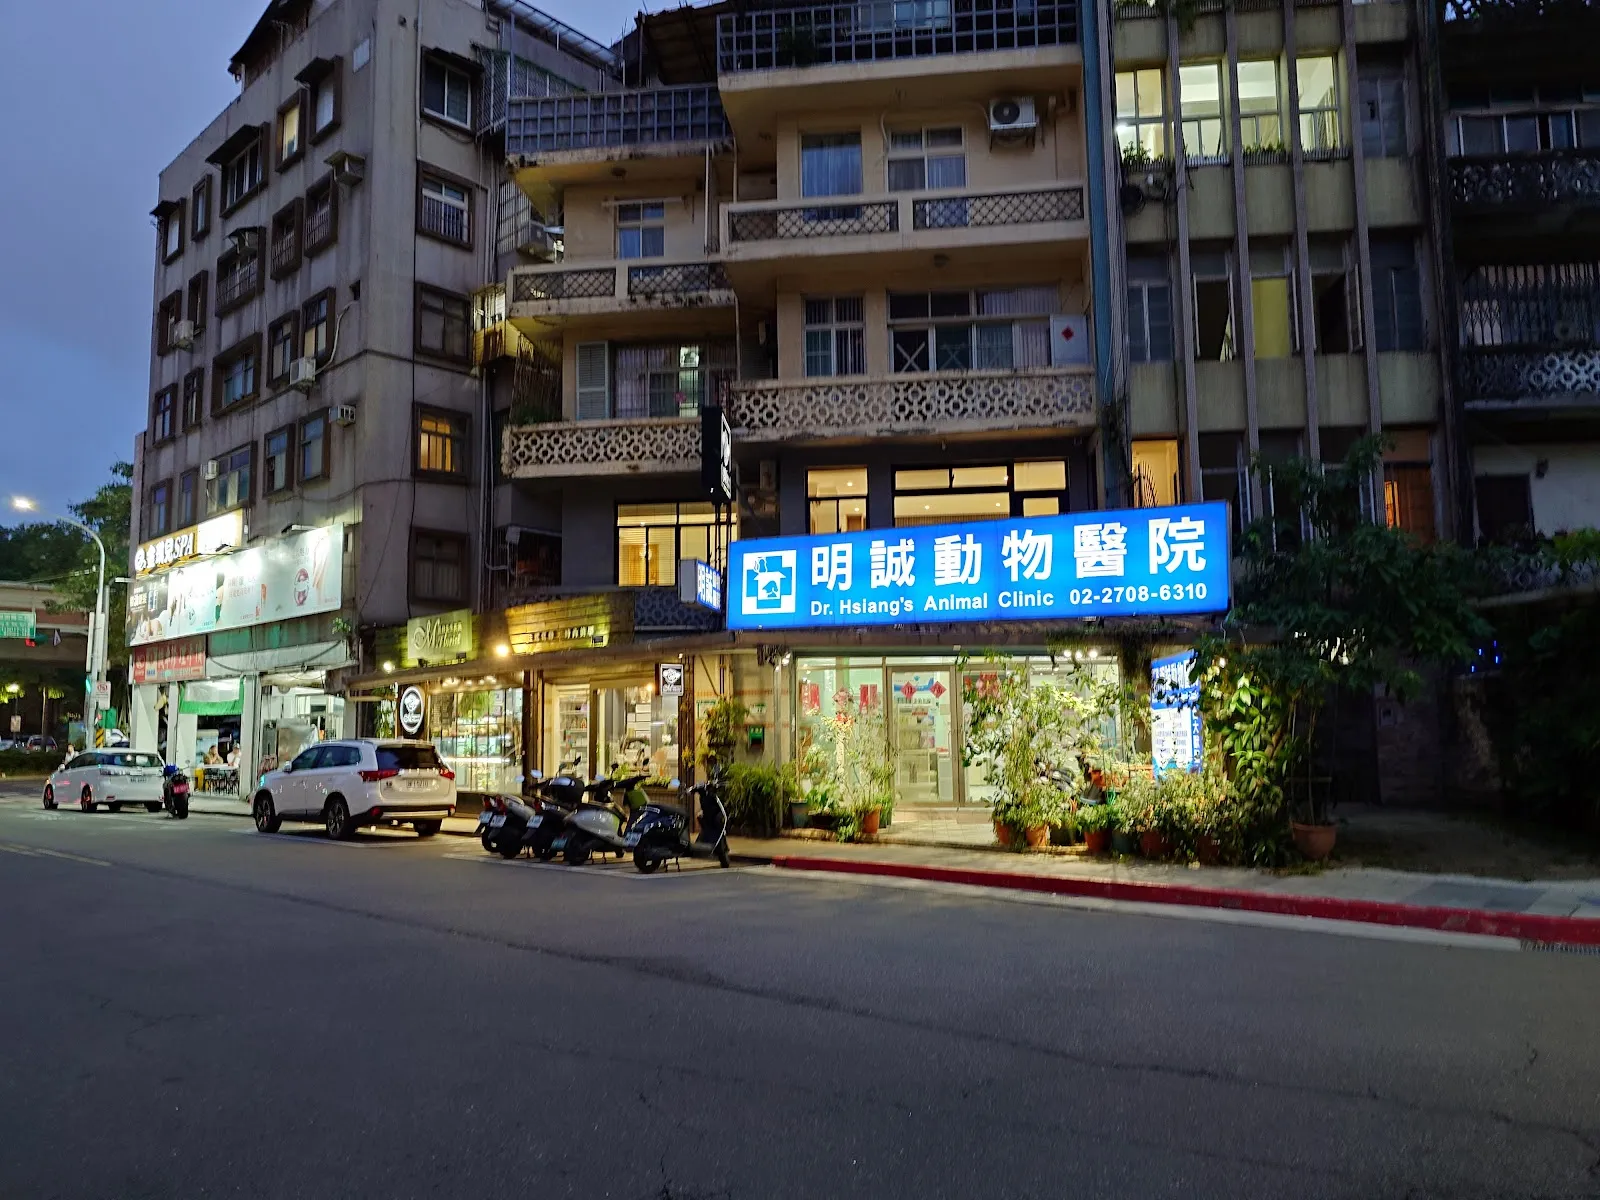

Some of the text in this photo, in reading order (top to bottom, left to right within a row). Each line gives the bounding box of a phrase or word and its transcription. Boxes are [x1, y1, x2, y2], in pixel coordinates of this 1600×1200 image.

[811, 516, 1207, 591] 明誠動物醫院
[810, 582, 1207, 617] Dr. Hsiang's Animal Clinic 02-2708-6310
